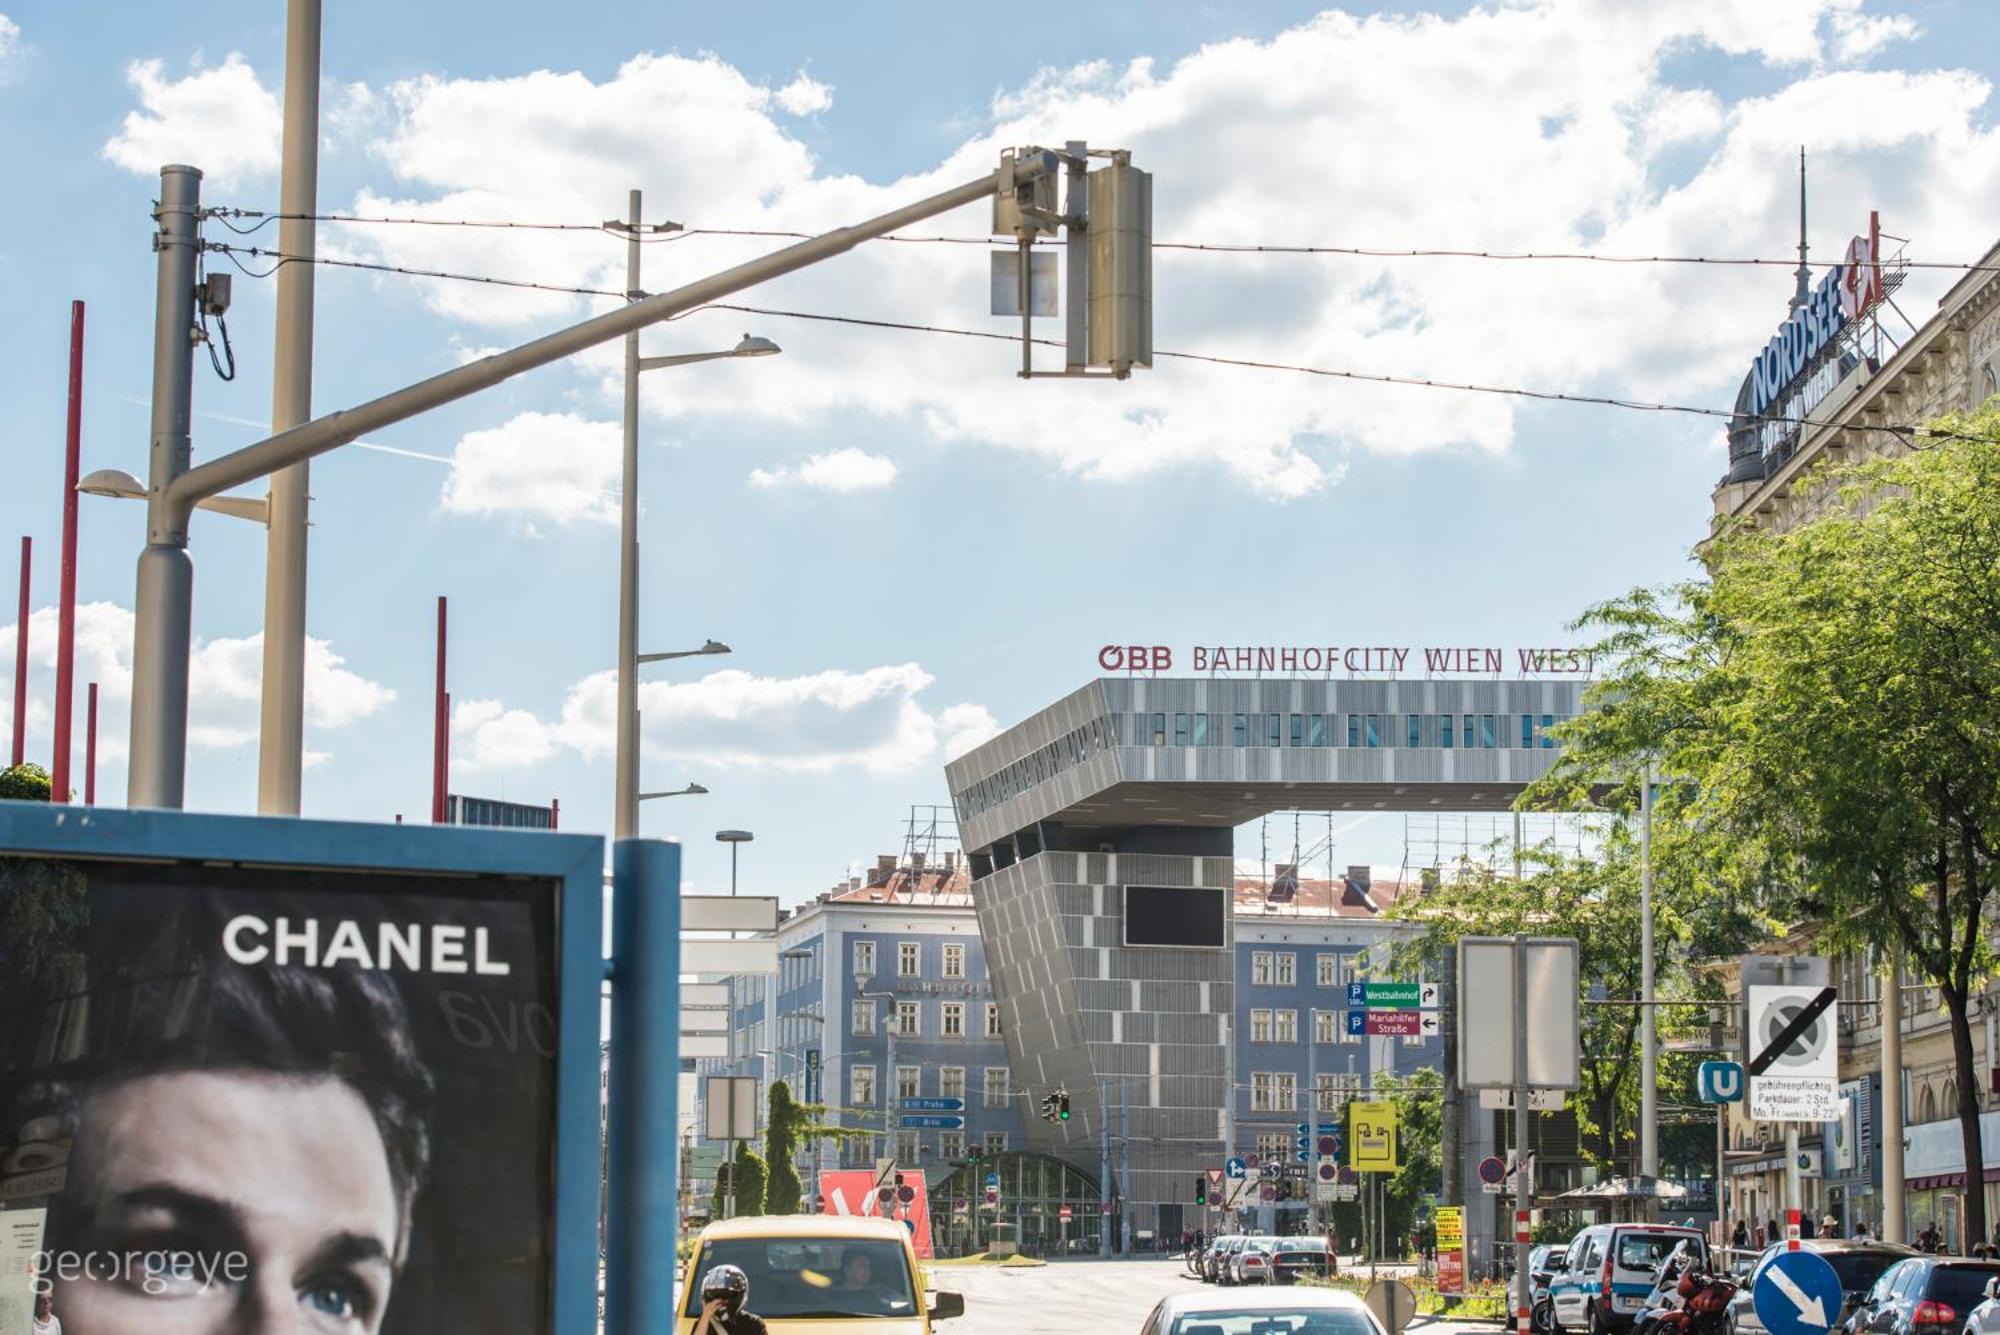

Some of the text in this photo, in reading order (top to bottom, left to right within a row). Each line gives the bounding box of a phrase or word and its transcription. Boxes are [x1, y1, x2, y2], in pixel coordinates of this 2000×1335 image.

[1752, 265, 1846, 414] NORDSEE
[1193, 647, 1411, 672] BAHNHOFCITY
[1424, 648, 1502, 673] WIEN
[1518, 648, 1598, 673] WEST
[222, 914, 511, 975] CHANEL
[1366, 990, 1420, 1000] Westbahnhof
[1369, 1013, 1417, 1023] Mariahilfer
[1378, 1024, 1408, 1033] Straße
[1713, 1070, 1738, 1097] U
[1757, 1079, 1832, 1092] gebührenpflichtig
